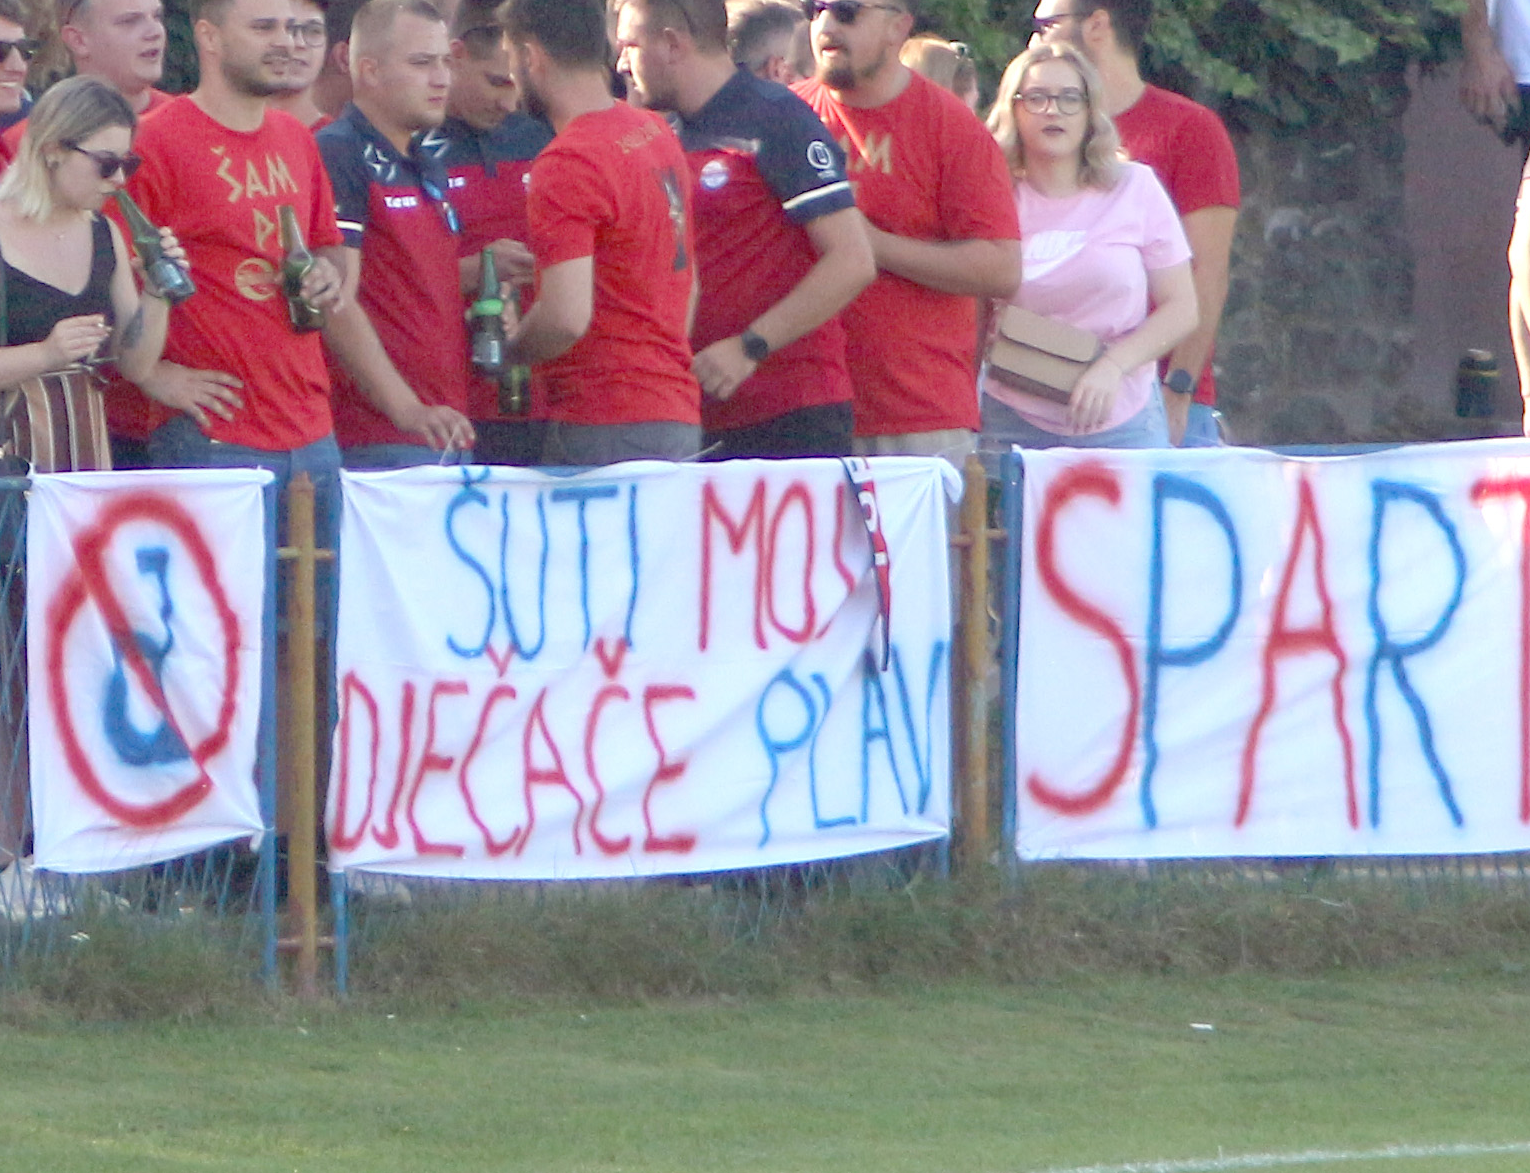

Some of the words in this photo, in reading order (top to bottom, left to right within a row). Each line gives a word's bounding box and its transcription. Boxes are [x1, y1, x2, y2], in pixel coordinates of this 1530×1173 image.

[210, 144, 299, 204] ŠAM
[445, 466, 640, 661] ŠUTI
[330, 636, 698, 859] DJEČAČE
